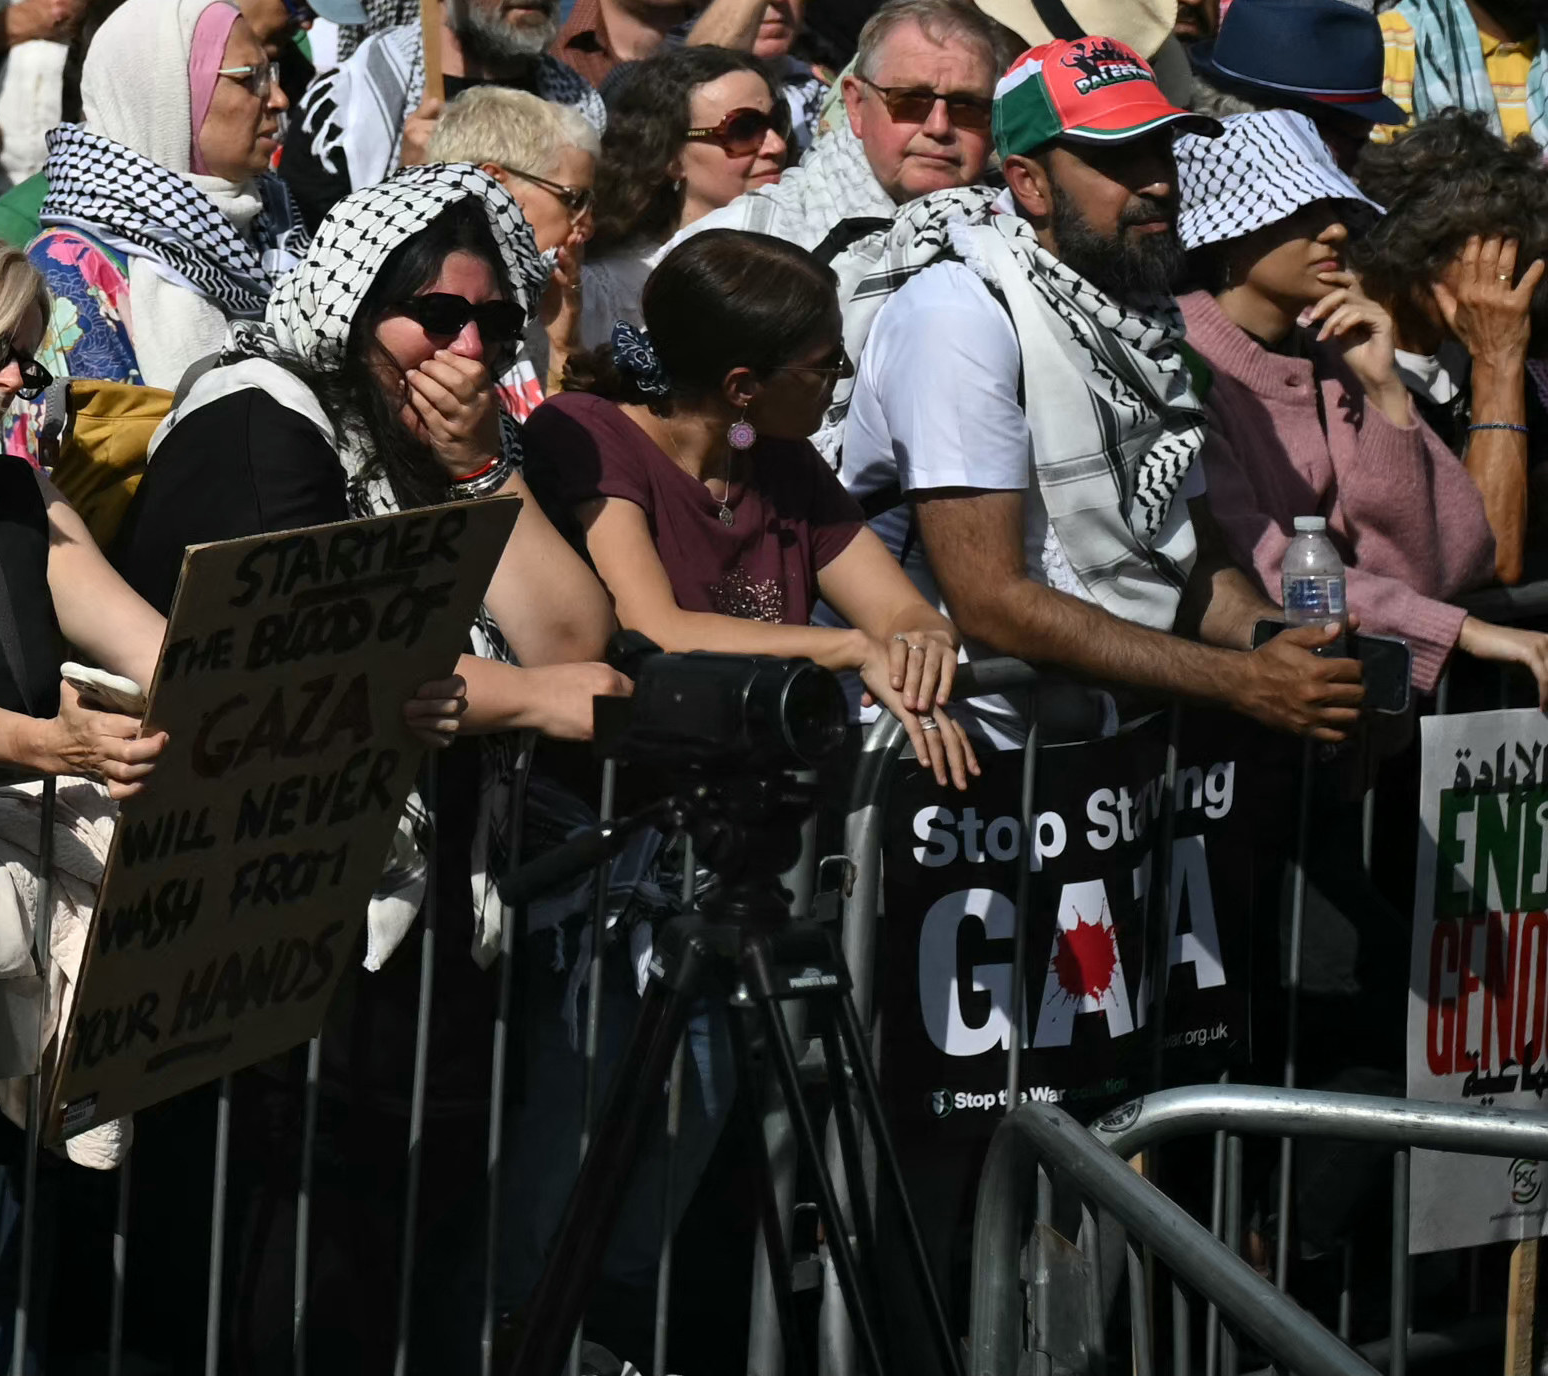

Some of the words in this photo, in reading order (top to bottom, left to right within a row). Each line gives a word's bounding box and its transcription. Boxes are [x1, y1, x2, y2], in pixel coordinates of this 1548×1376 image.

[229, 510, 467, 608] STARMER
[163, 624, 233, 682] THE
[245, 596, 377, 673] BLOOD
[377, 578, 458, 649] OF
[191, 671, 375, 779] GAZA
[122, 808, 217, 869] WILL
[234, 746, 401, 844] NEVER
[912, 804, 1068, 872] Stop
[99, 878, 205, 956] WASH
[229, 842, 349, 923] FROM
[71, 992, 160, 1070] YOUR
[169, 918, 346, 1038] HANDS
[954, 1091, 996, 1111] Stop
[1029, 1085, 1067, 1103] War
